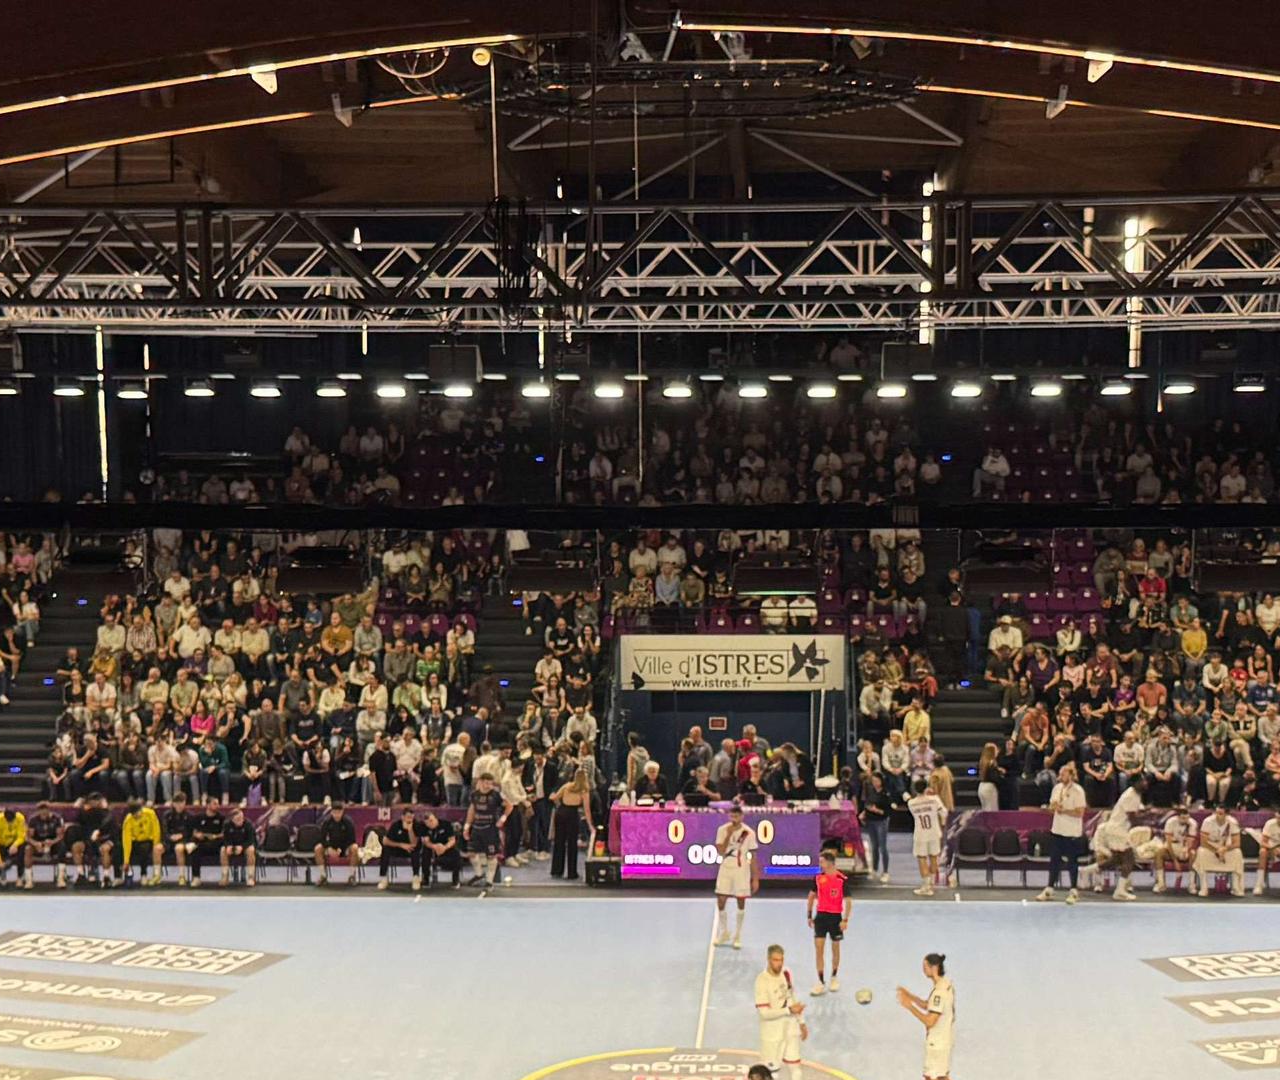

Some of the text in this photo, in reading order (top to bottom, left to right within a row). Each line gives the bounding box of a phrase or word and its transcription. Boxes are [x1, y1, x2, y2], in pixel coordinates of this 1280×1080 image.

[634, 654, 785, 676] Ville d'ISTRES
[672, 678, 752, 689] www.istres.fr
[668, 819, 774, 844] 0 0
[610, 1062, 750, 1074] tarLigue
